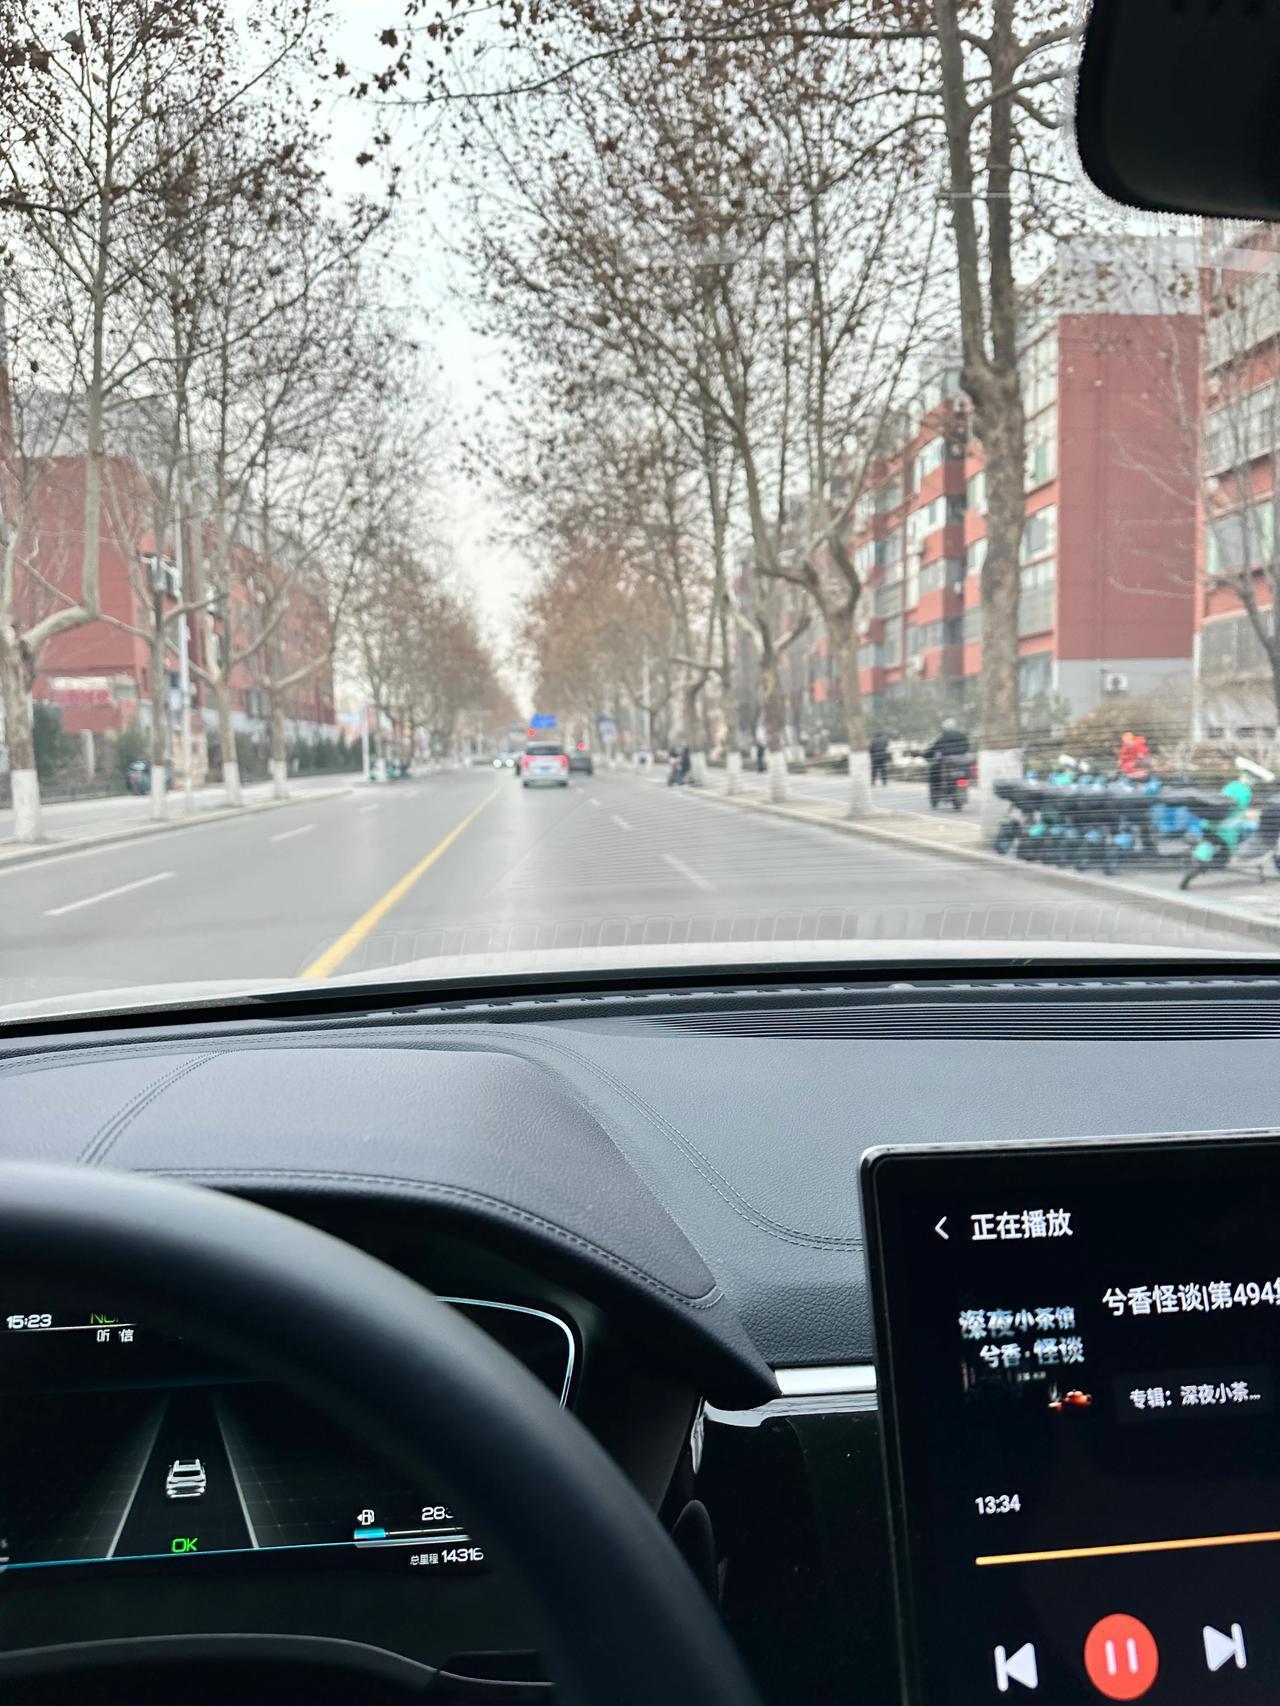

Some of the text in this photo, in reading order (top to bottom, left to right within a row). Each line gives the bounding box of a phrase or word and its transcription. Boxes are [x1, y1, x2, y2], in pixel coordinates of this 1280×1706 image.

[970, 1208, 1074, 1241] 正在播放
[6, 1313, 52, 1329] 15:23
[958, 1306, 1076, 1340] 深夜小茶馆
[975, 1494, 1021, 1515] 13:34
[171, 1537, 199, 1553] OK
[410, 1553, 439, 1565] 总里程
